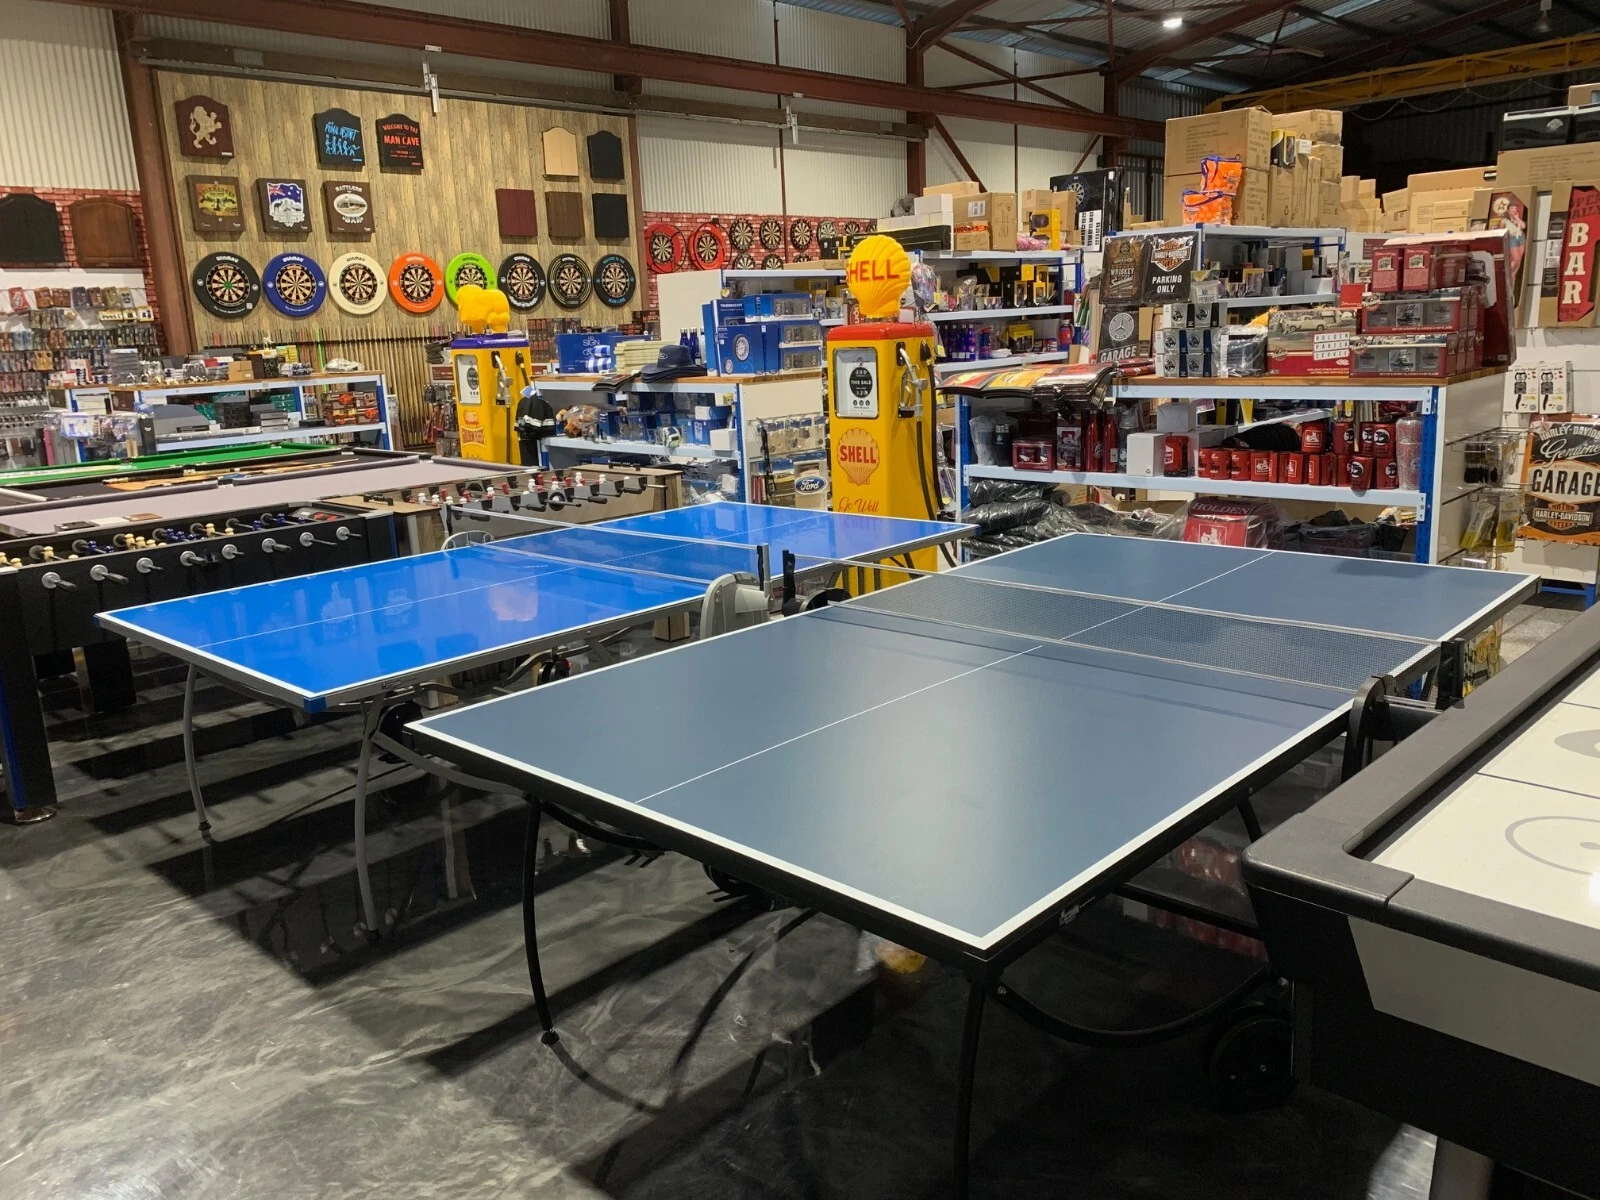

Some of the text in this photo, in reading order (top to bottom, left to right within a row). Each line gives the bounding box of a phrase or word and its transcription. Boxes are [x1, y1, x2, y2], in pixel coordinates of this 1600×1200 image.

[384, 135, 420, 146] MAN CAVE
[1562, 223, 1589, 304] BAR
[1110, 267, 1135, 276] WHISKEY
[1152, 274, 1182, 284] PARKING
[1156, 284, 1175, 294] ONLY
[1315, 333, 1349, 341] HOLDEN
[582, 339, 600, 347] SIGN
[1101, 346, 1137, 362] GARAGE
[839, 445, 877, 464] SHELL
[800, 479, 820, 491] Ford
[854, 498, 879, 513] Well
[1192, 502, 1251, 515] HOLDEN
[1551, 503, 1576, 512] MOTOR
[1536, 510, 1591, 523] HARLEY-DAVIDSON
